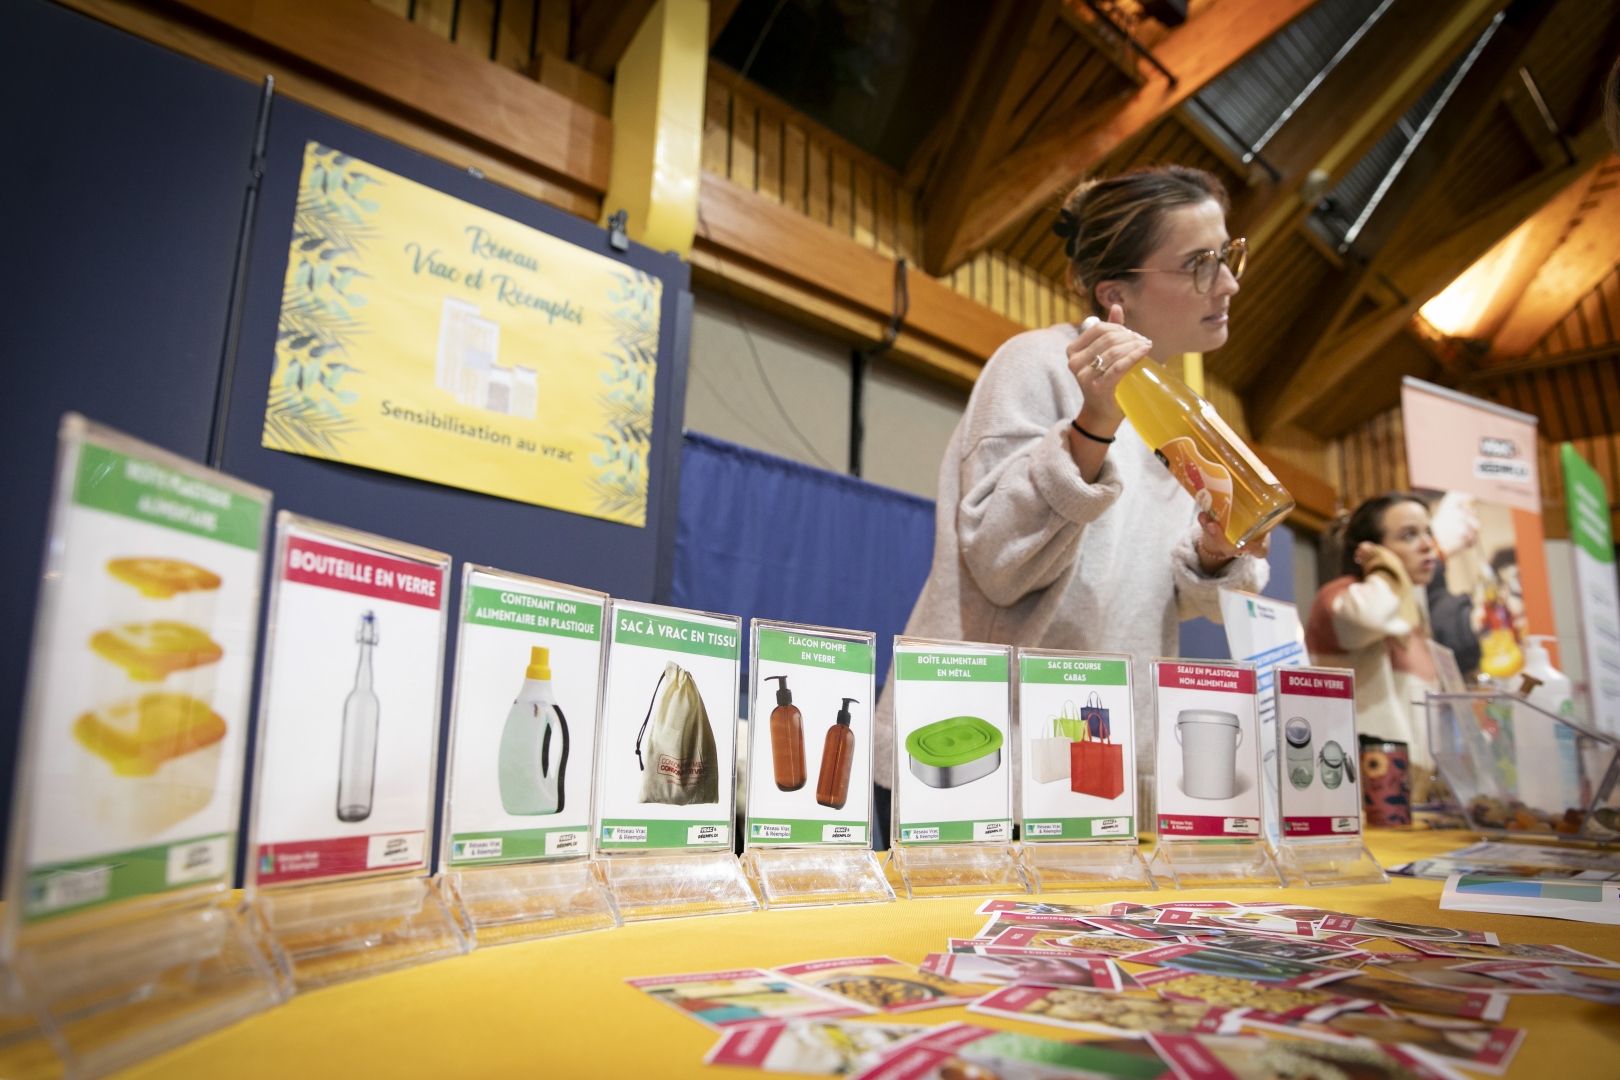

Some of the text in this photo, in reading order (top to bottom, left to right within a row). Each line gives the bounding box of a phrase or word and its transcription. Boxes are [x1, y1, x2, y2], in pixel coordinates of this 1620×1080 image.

[464, 226, 539, 272] Réseau
[404, 242, 584, 325] Vrac et Réemploi
[381, 400, 574, 462] Sensibilisation au vrac
[290, 548, 436, 598] BOUTEILLE EN VERRE
[500, 592, 577, 615] CONTENANT NON
[476, 607, 594, 634] ALIMENTAIRE EN PLASTIQUE
[620, 618, 736, 648] SAC À VRAC EN TISSU
[788, 636, 846, 653] FLACON POMPE
[801, 652, 835, 664] EN VERRE
[918, 655, 987, 666] BOÎTE ALIMENTAIRE
[937, 668, 971, 678] EN MÉTAL
[1074, 662, 1101, 670] COURSE
[1177, 666, 1194, 674] SEAU
[1205, 668, 1240, 678] PLASTIQUE
[1064, 674, 1086, 682] CABAS
[1196, 679, 1238, 689] ALIMENTAIRE
[1289, 676, 1344, 690] BOCAL EN VERRE
